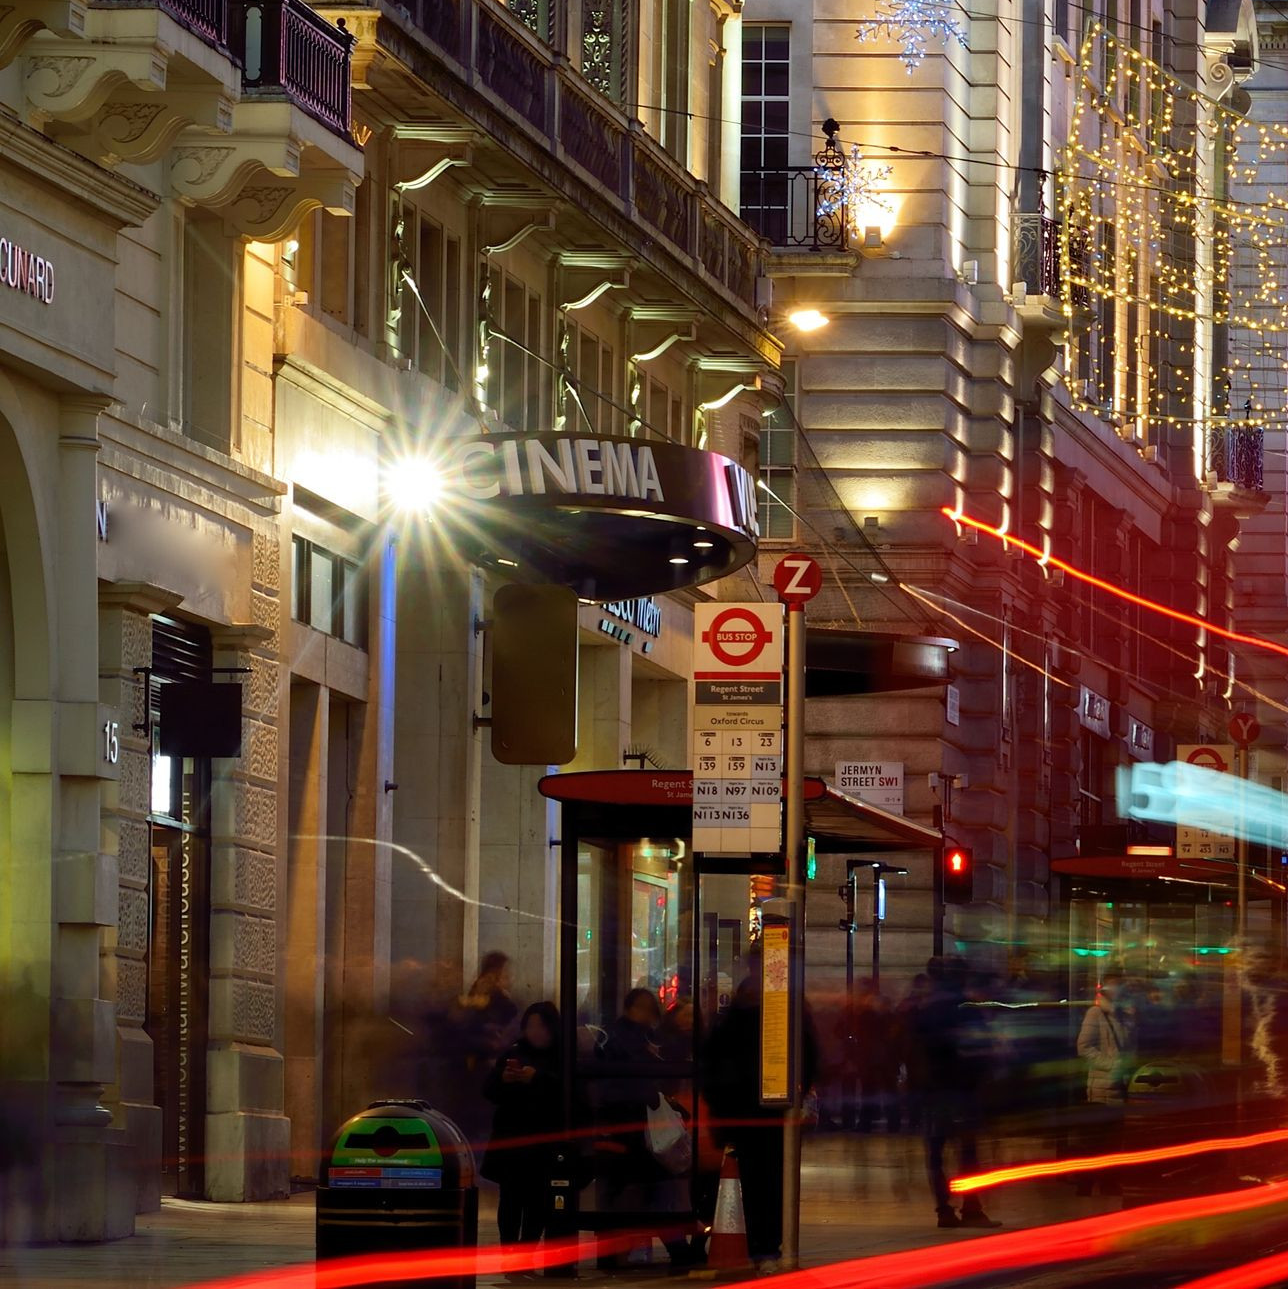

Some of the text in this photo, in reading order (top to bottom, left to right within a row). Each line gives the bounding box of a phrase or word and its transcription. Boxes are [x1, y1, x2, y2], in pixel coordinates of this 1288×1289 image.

[0, 237, 55, 304] CUNARD
[459, 438, 665, 504] CINEMA
[783, 560, 812, 594] Z
[716, 632, 758, 641] BUS STOP
[711, 685, 764, 694] Regent Street
[710, 717, 764, 726] Oxford Circus
[1237, 718, 1254, 741] Y
[103, 720, 118, 763] 15
[705, 738, 712, 747] 6
[731, 738, 743, 747] 13
[760, 738, 773, 747] 23
[699, 762, 716, 771] 139
[728, 762, 745, 771] 159
[755, 762, 776, 771] N13
[841, 765, 882, 775] JERMYN
[651, 779, 686, 790] Regent
[841, 777, 899, 787] STREET SW1
[697, 786, 718, 795] N18
[725, 787, 747, 796] N97
[752, 787, 779, 796] N109
[694, 811, 720, 820] N113
[722, 811, 749, 820] N136
